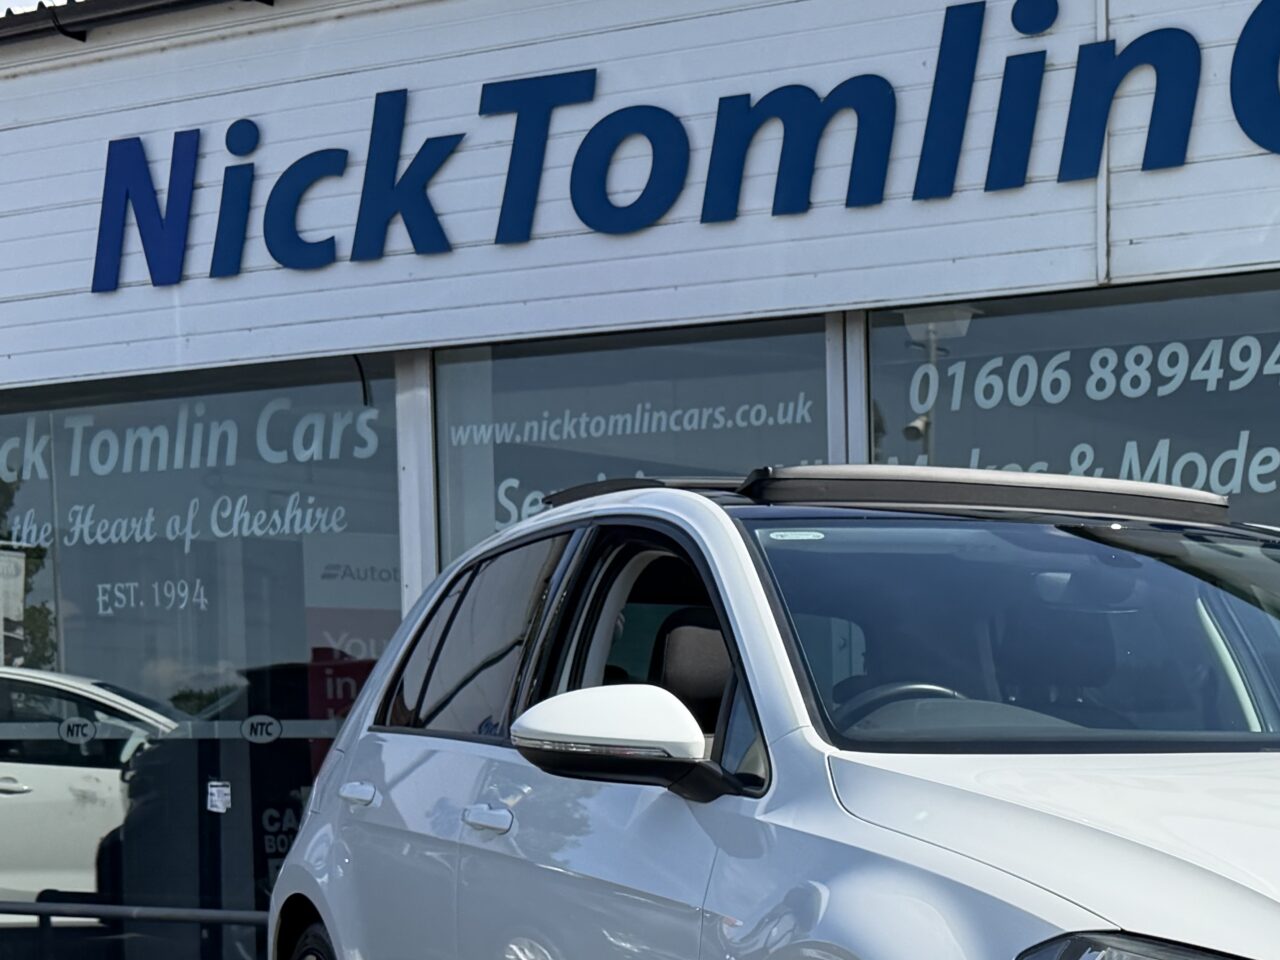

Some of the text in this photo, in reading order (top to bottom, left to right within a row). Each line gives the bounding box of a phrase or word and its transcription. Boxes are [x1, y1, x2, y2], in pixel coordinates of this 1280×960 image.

[909, 351, 1072, 414] 01606
[64, 403, 238, 477] Tomlin
[256, 400, 380, 463] Cars
[450, 392, 813, 447] www.nicktomlincars.co.uk
[11, 491, 348, 554] the Heart of Cheshire
[97, 579, 208, 616] EST. 1994
[66, 723, 89, 738] NTC
[249, 722, 274, 737] NTC
